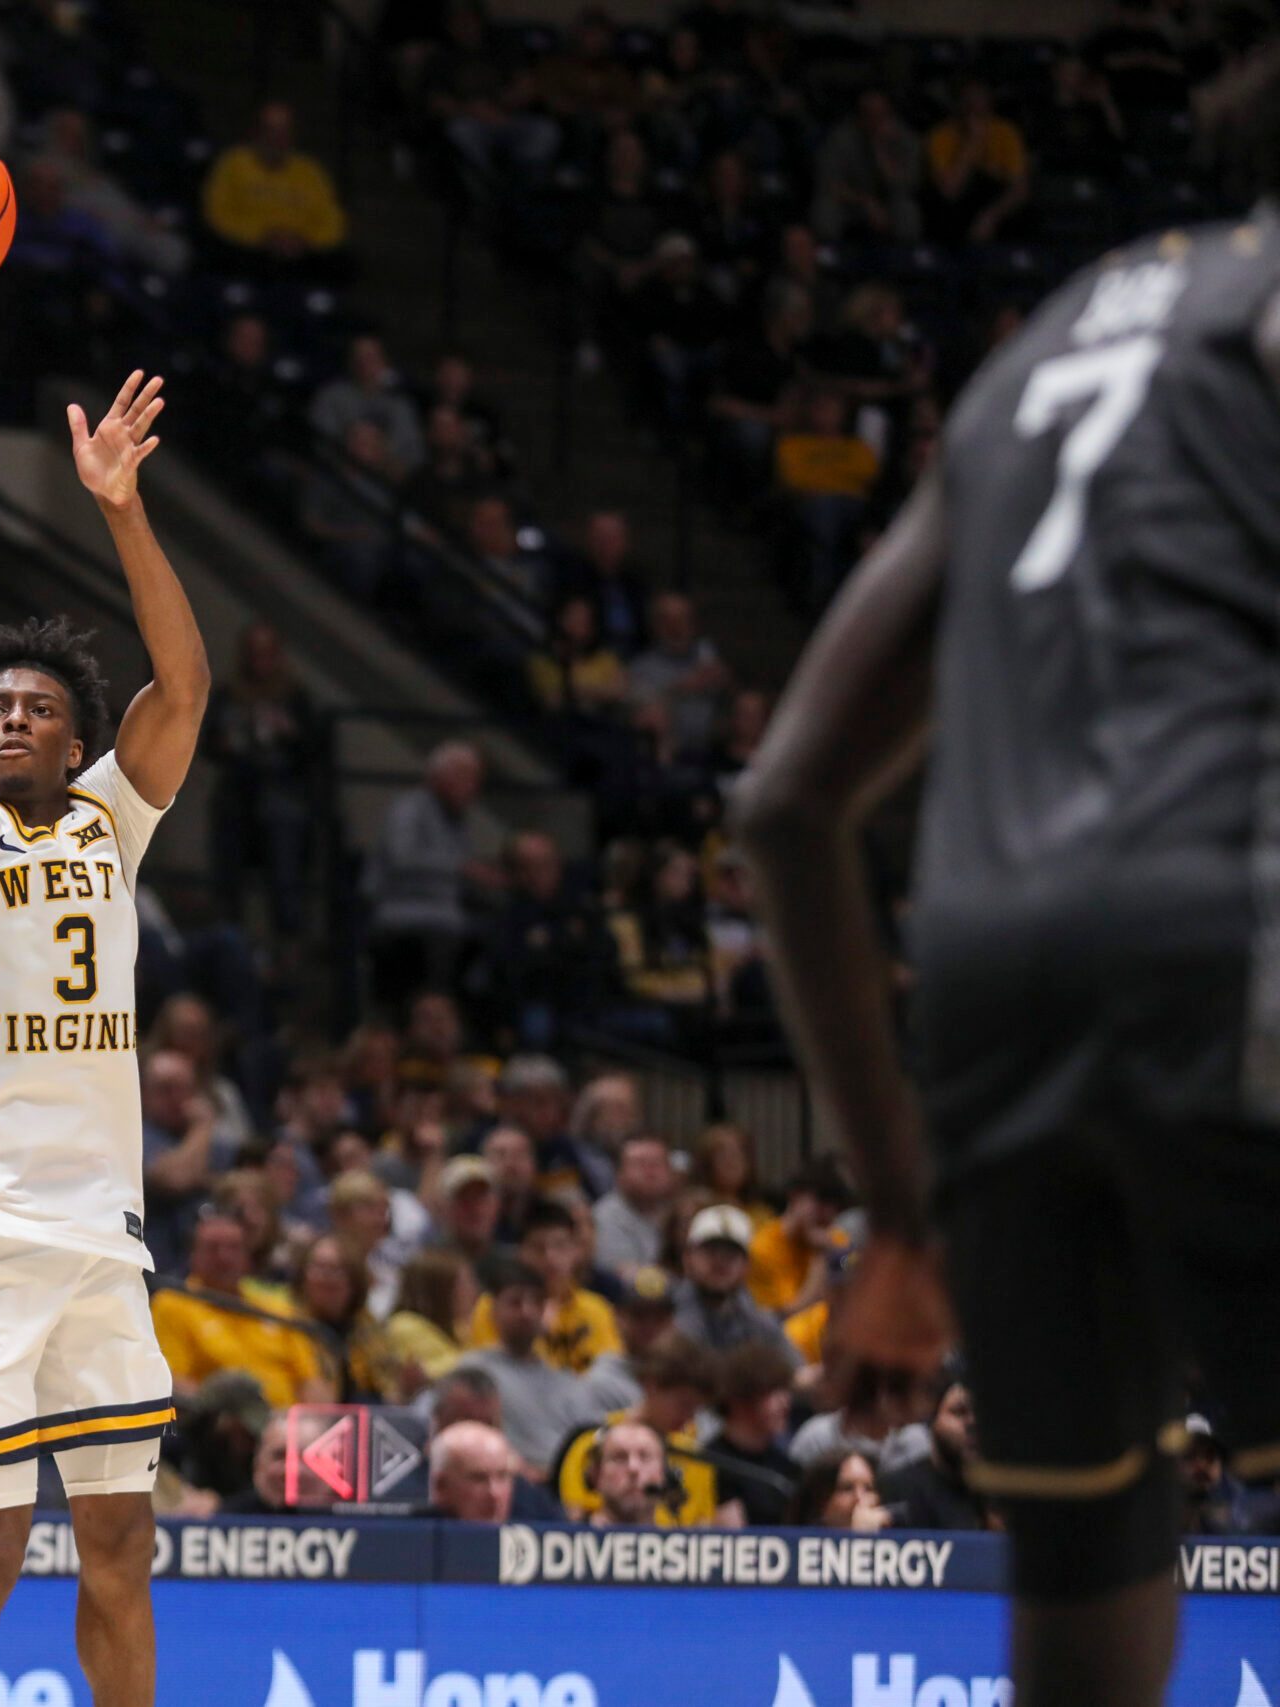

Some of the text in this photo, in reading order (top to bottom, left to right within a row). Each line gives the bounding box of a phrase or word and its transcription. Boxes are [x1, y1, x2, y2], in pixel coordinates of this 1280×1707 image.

[1011, 333, 1166, 594] 7
[53, 912, 99, 1004] 3
[180, 1526, 358, 1578] ENERGY
[542, 1531, 789, 1584] DIVERSIFIED
[798, 1537, 954, 1588] ENERGY
[1175, 1544, 1280, 1591] VERSI
